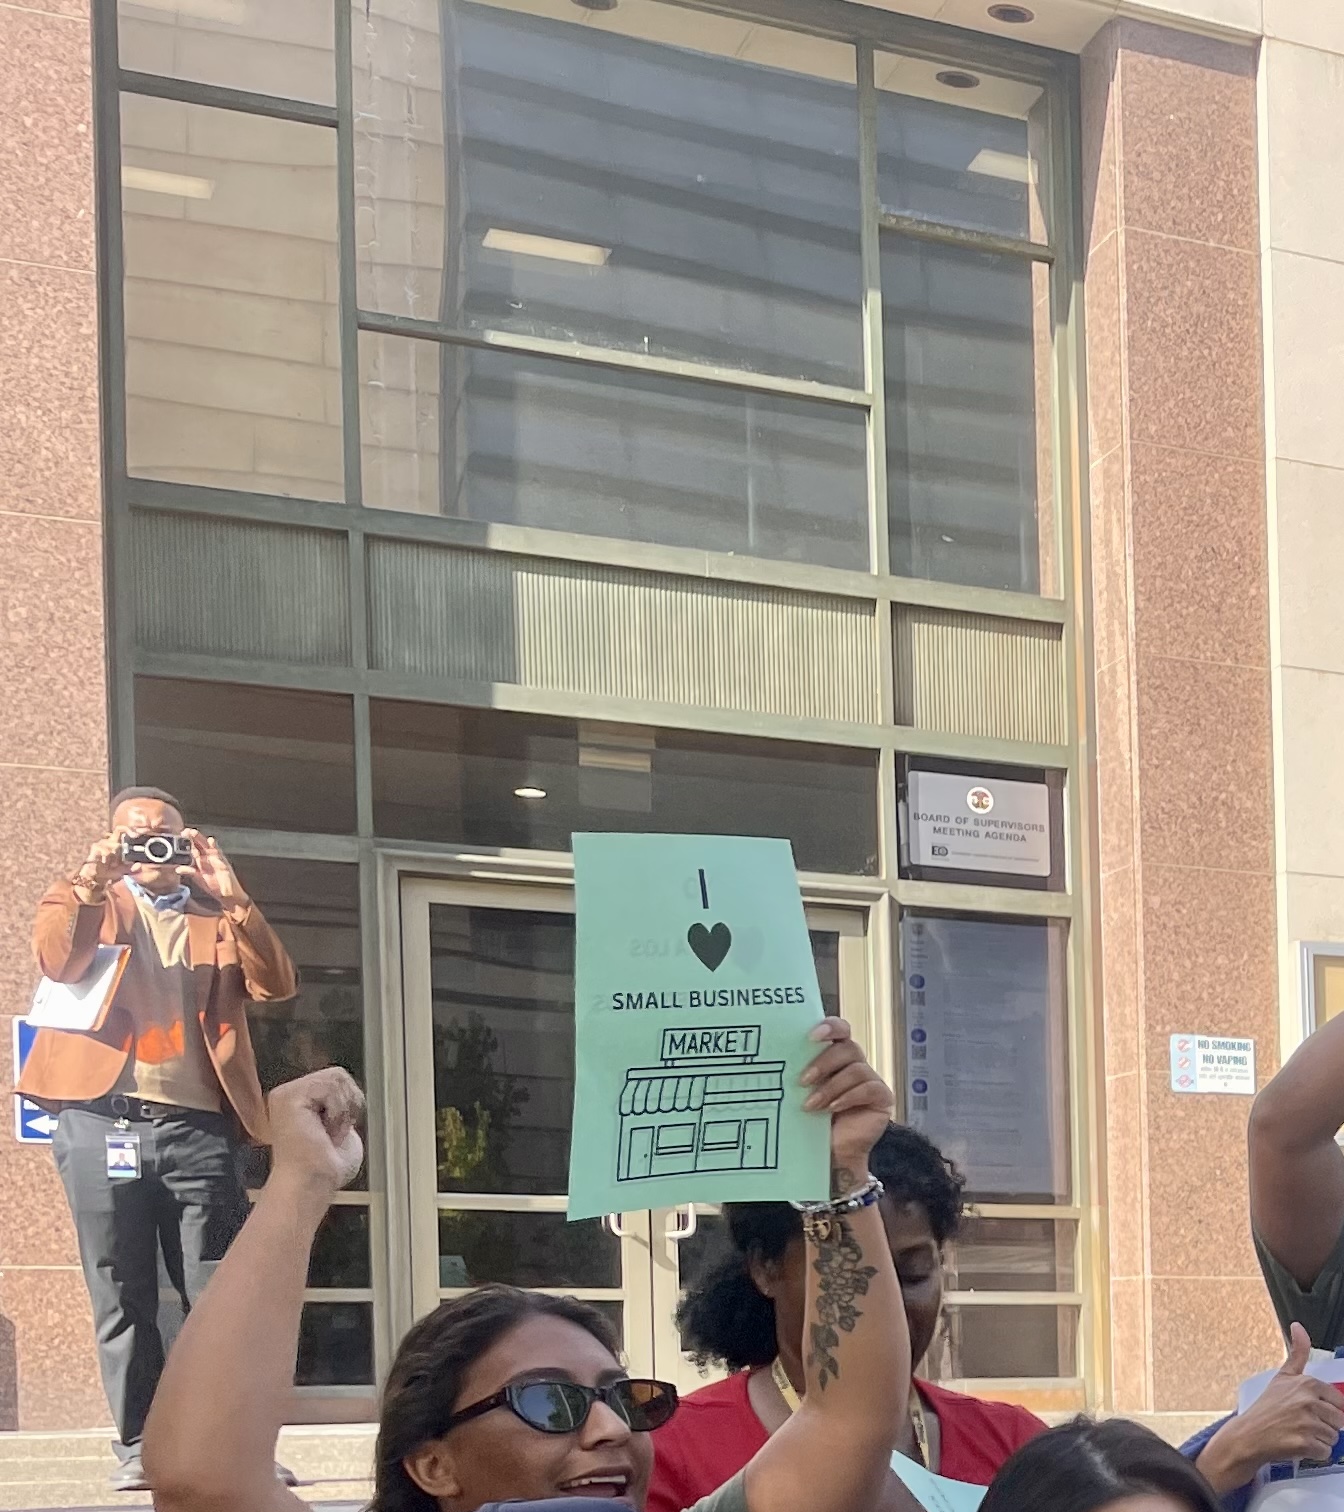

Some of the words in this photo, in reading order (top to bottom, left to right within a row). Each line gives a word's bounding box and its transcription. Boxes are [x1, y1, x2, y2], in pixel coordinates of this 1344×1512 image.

[913, 812, 950, 823] BOARD
[955, 816, 969, 824] OF
[974, 818, 1045, 832] SUPERVISORS
[933, 826, 980, 838] MEETING
[984, 831, 1027, 842] AGENDA
[698, 868, 709, 909] I
[612, 991, 683, 1010] SMALL
[690, 987, 805, 1008] BUSINESSES
[668, 1030, 753, 1055] MARKET
[1198, 1040, 1209, 1049] NO
[1212, 1040, 1251, 1051] SMOKING
[1203, 1054, 1214, 1064] NO
[1217, 1055, 1247, 1065] VAPING
